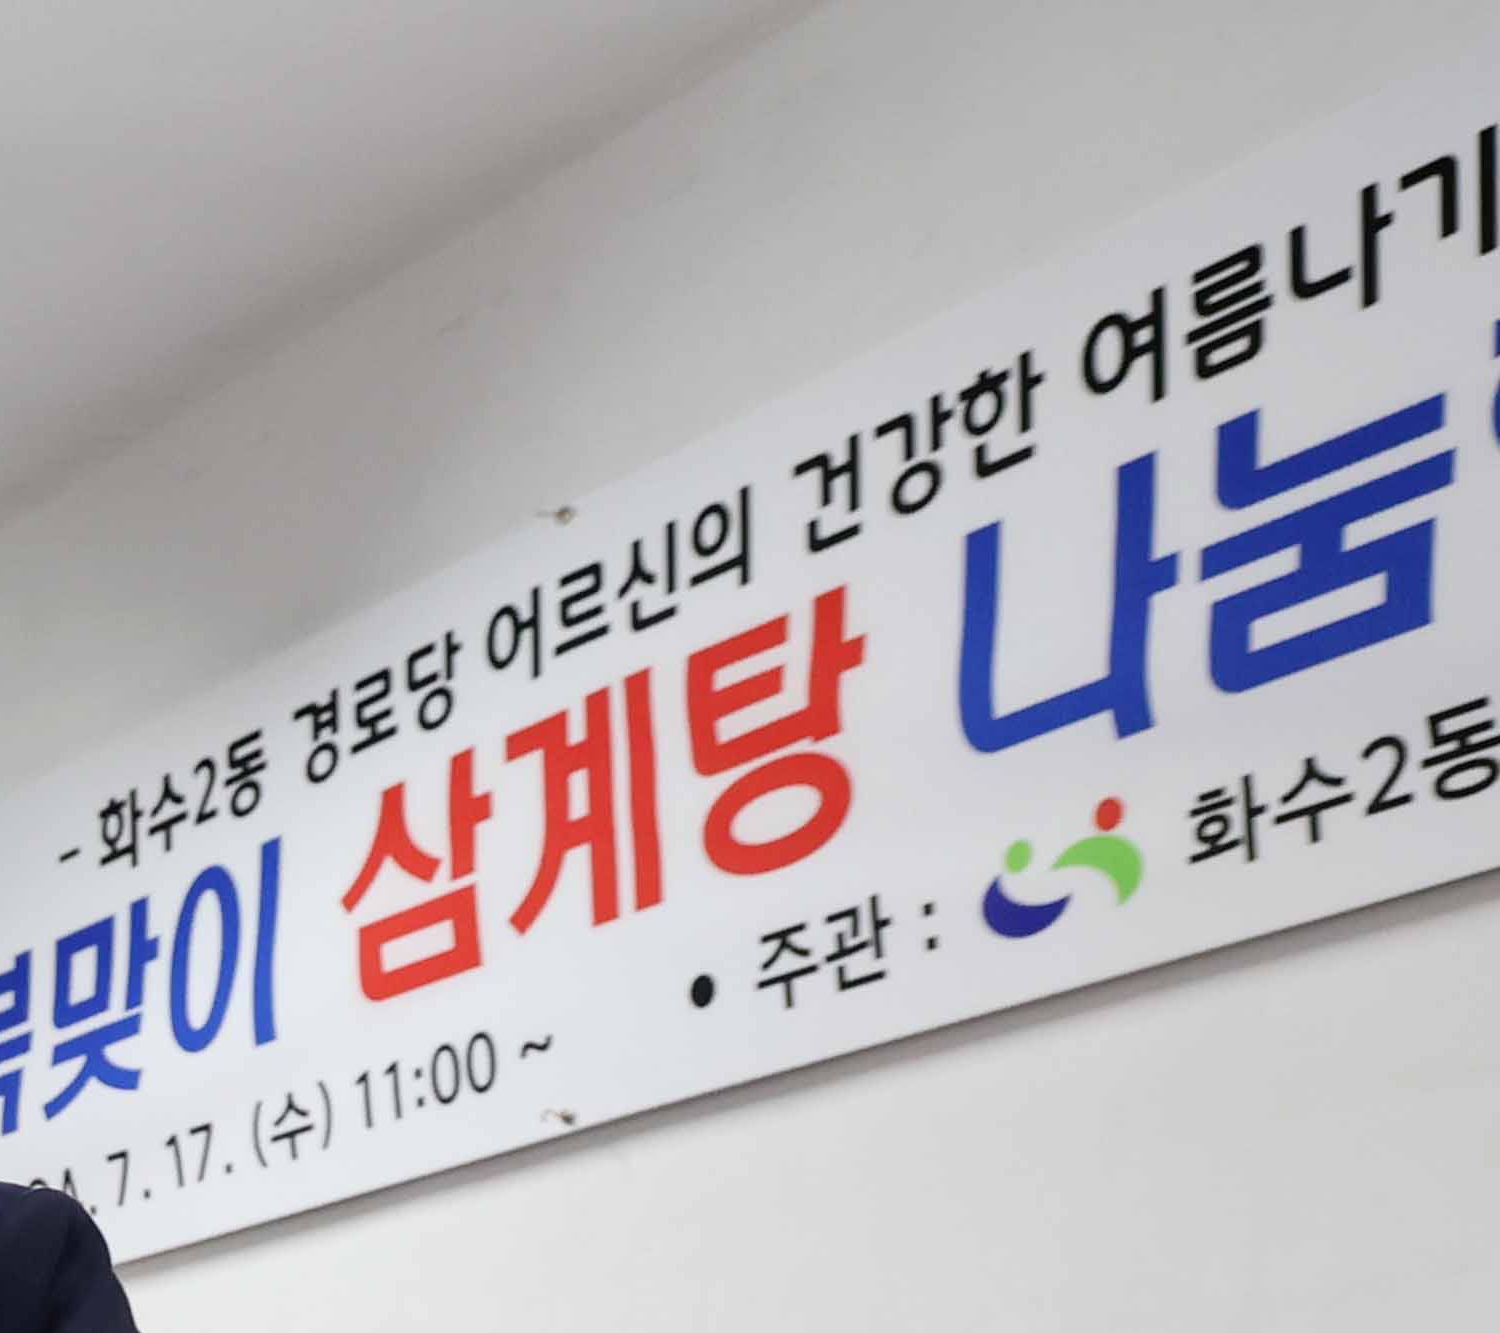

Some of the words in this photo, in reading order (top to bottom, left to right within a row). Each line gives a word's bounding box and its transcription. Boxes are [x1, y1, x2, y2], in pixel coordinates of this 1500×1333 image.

[99, 730, 268, 869] 화수2동
[293, 630, 462, 785] 경로당
[485, 484, 753, 680] 어르신의
[792, 349, 1045, 553] 건강한
[1081, 122, 1499, 403] 여름나기
[340, 582, 868, 1002] 삼계탕
[957, 320, 1500, 756] 나눔
[105, 1149, 152, 1208] 7.
[164, 1123, 234, 1187] 17.
[250, 1080, 334, 1170] (수)
[354, 1030, 497, 1130] 11:00
[756, 894, 892, 1009] 주관
